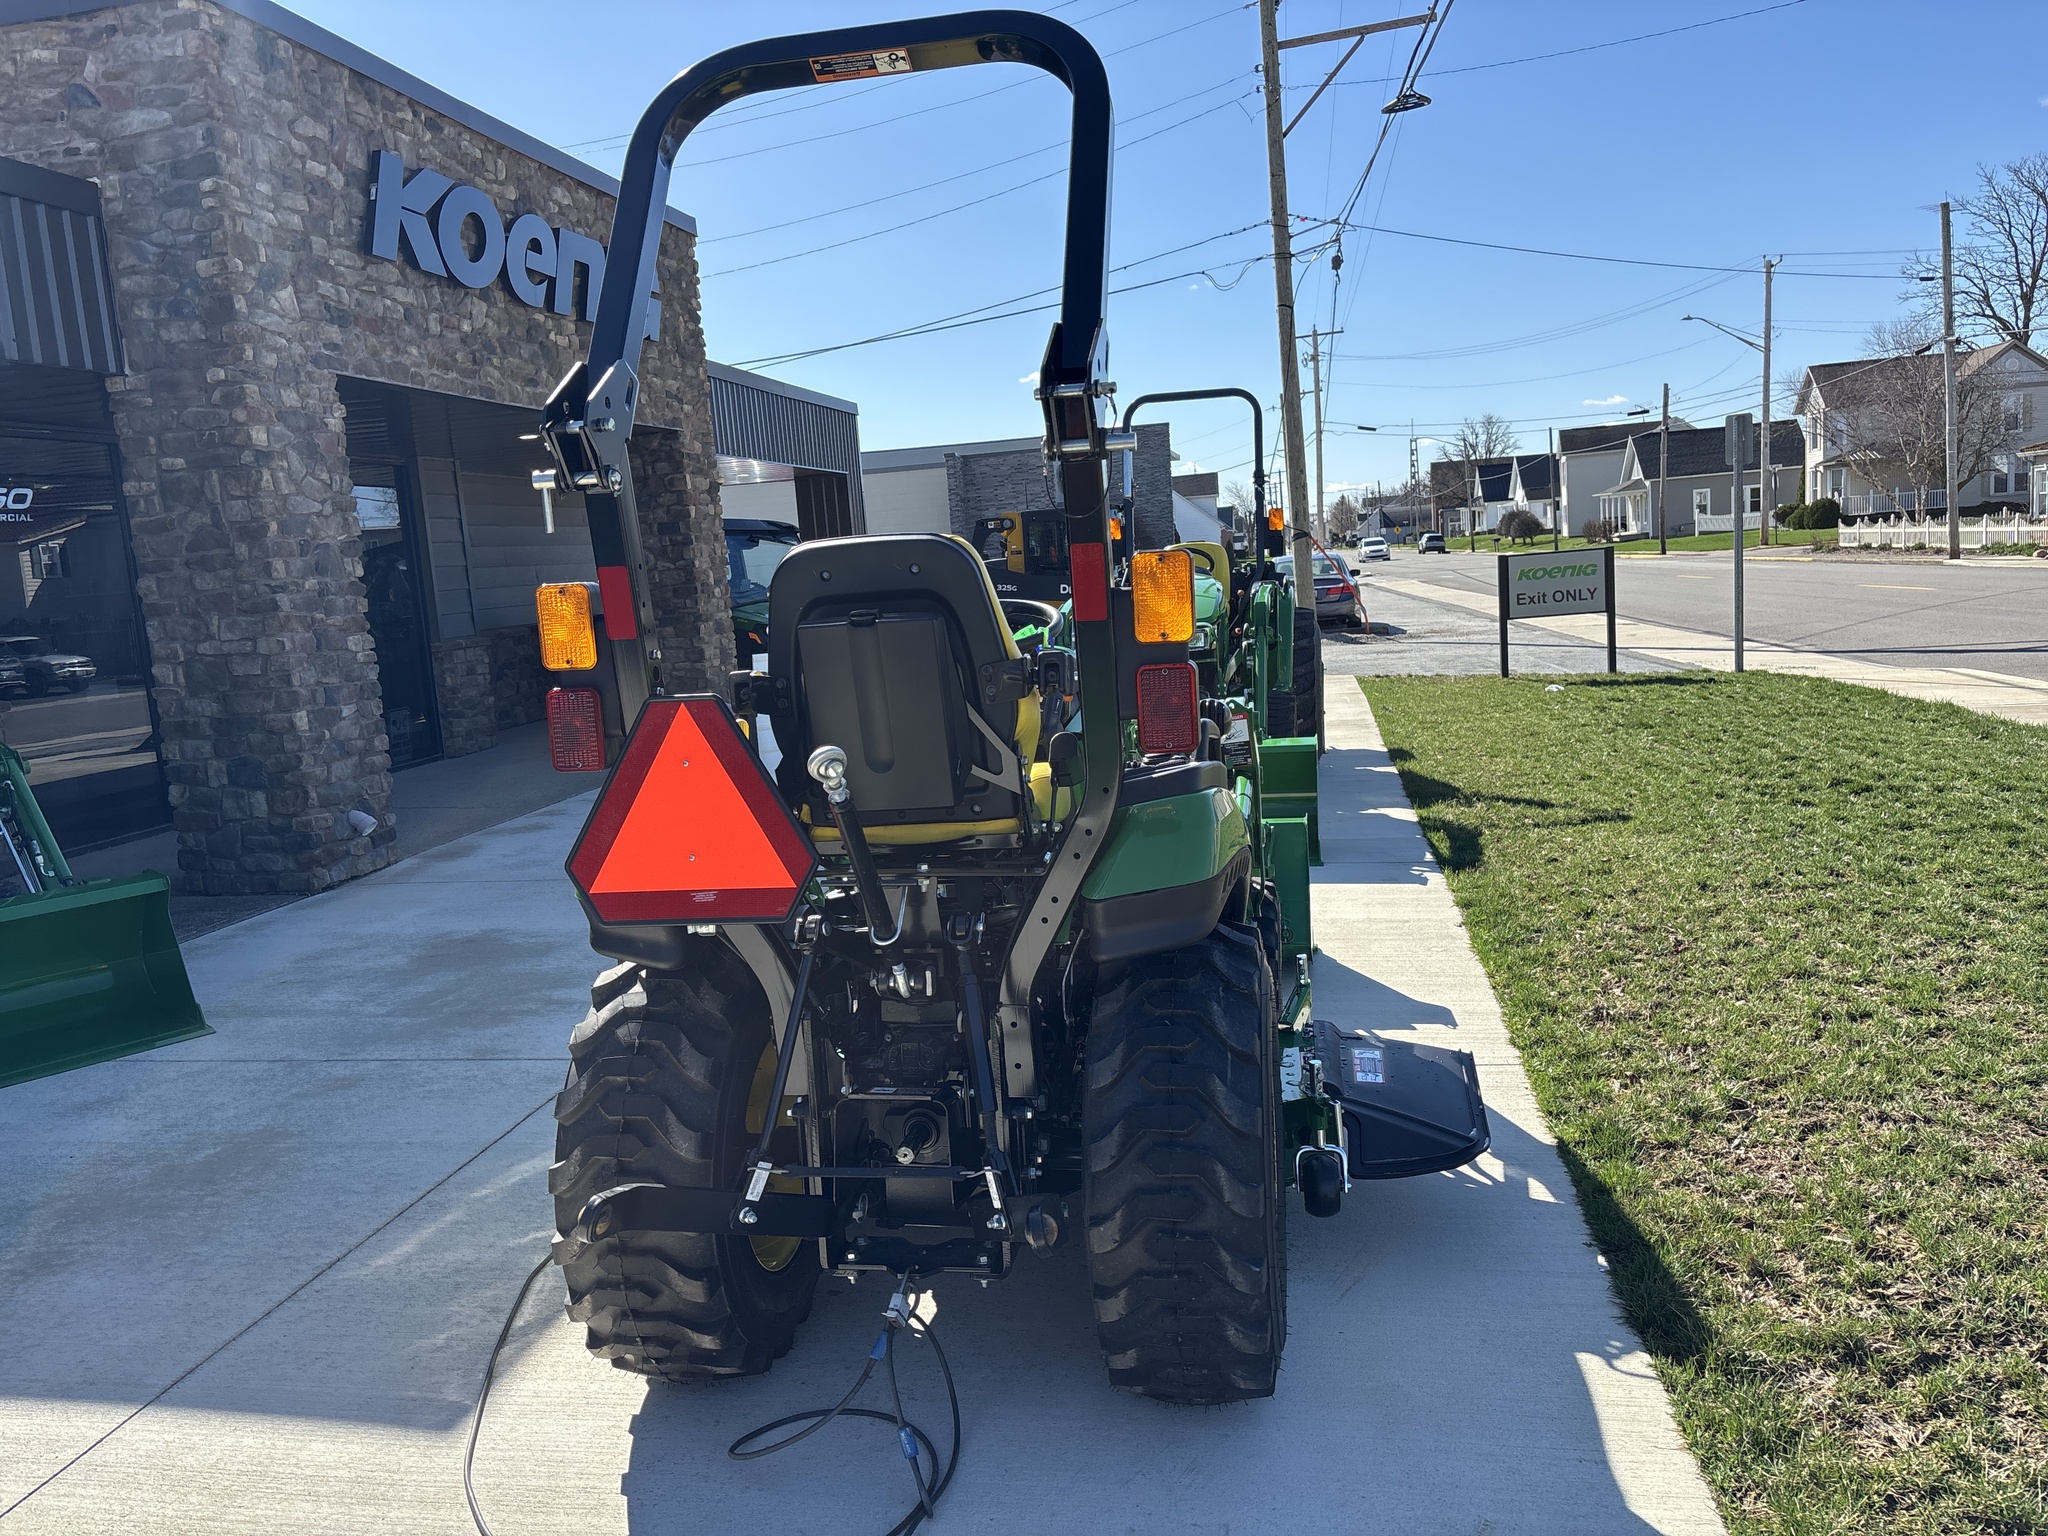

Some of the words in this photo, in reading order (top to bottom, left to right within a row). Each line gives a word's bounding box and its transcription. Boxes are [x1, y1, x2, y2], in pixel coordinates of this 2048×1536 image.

[996, 584, 1018, 592] 325G
[1516, 592, 1547, 606] Exit
[1552, 587, 1598, 603] ONLY
